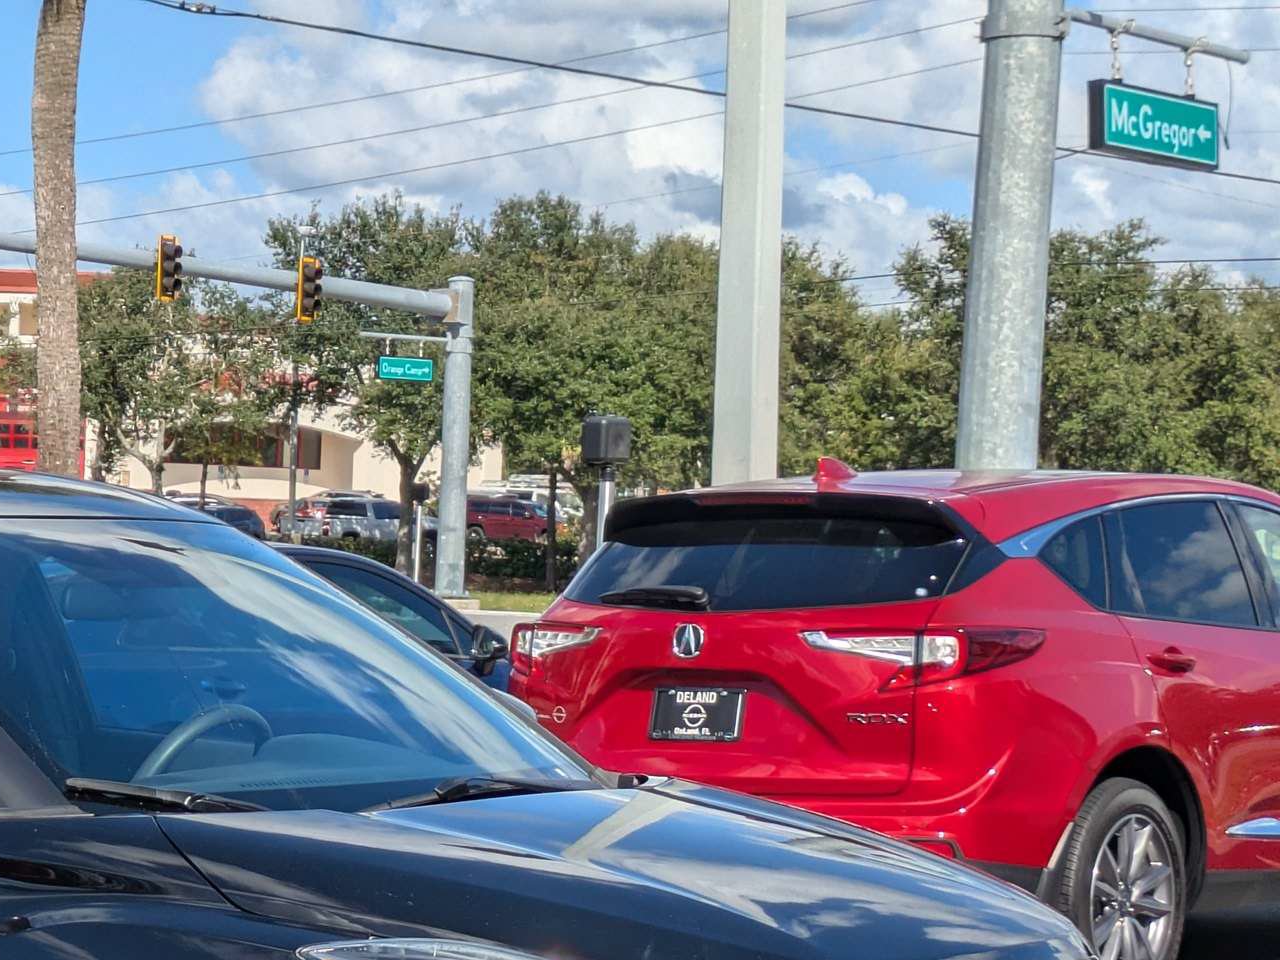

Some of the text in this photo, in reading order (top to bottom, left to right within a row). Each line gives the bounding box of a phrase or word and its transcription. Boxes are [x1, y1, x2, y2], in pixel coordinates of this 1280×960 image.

[1111, 98, 1196, 153] McGregor
[676, 691, 717, 703] DELAND
[846, 712, 909, 725] RDX
